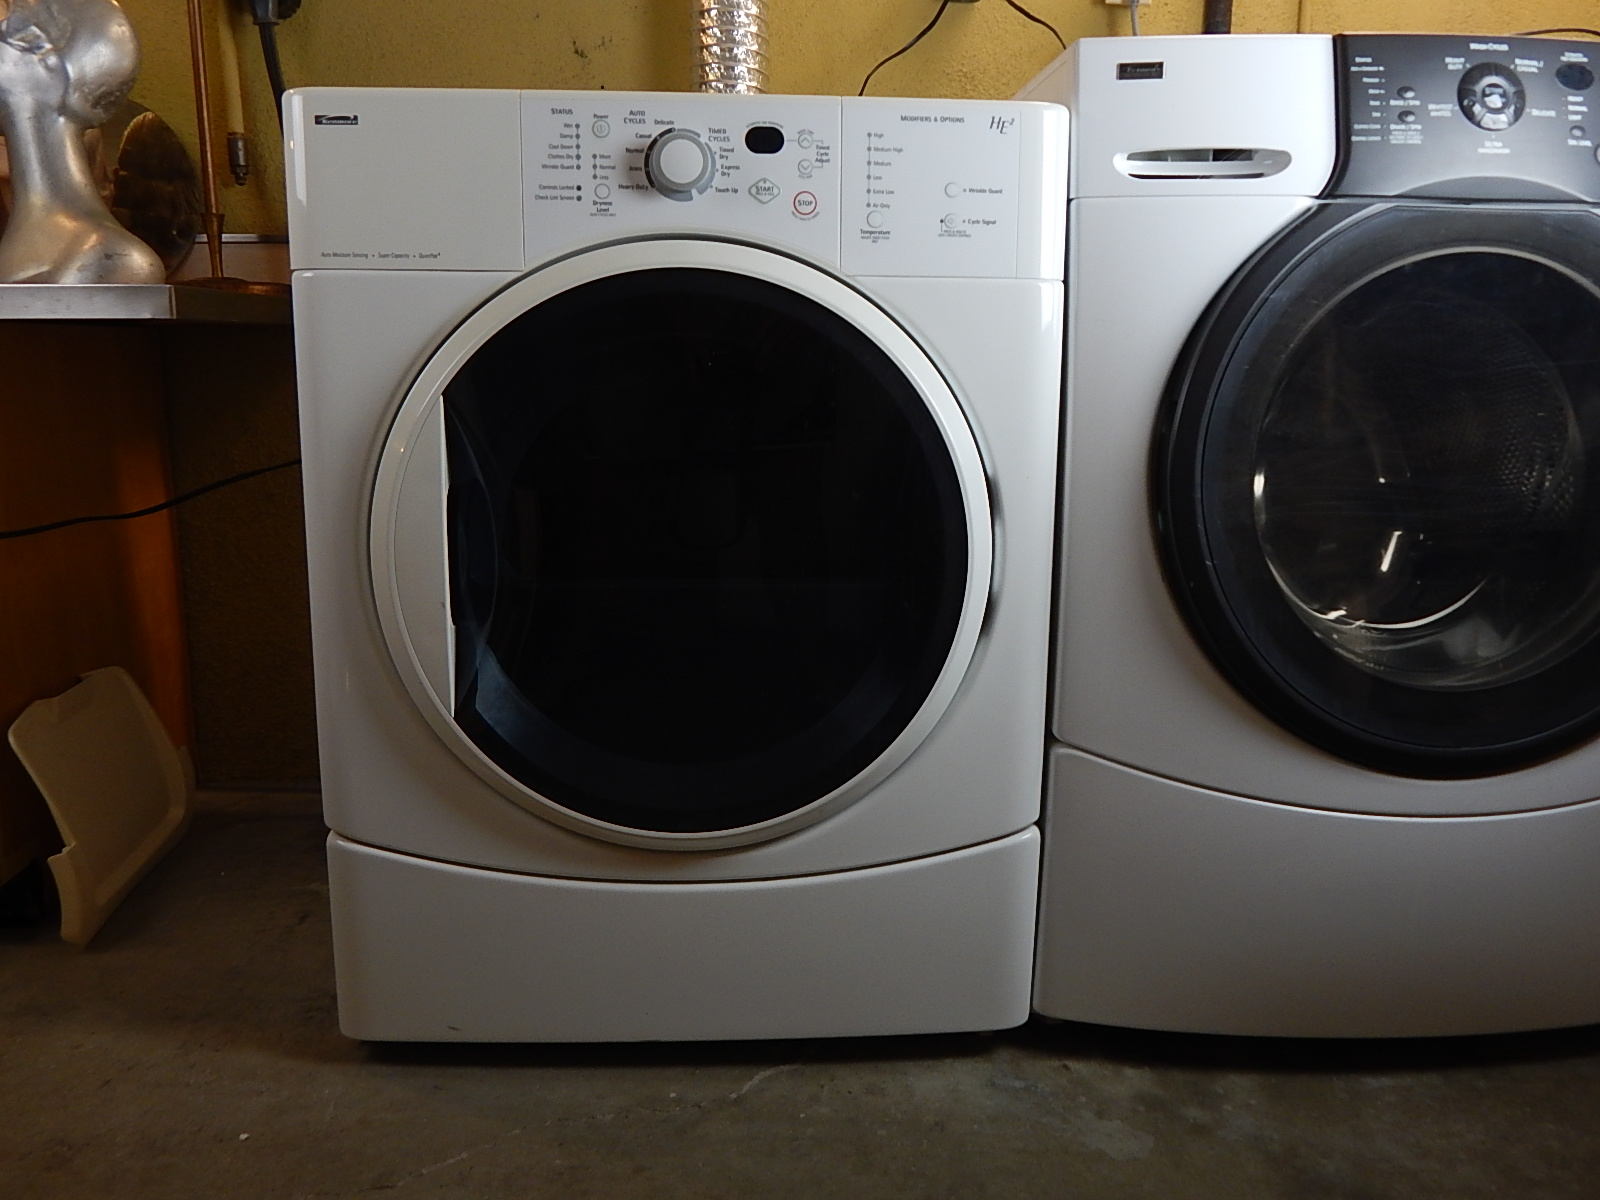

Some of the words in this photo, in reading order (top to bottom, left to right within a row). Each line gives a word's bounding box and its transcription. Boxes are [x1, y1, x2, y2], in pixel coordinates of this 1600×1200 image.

[755, 185, 774, 193] START
[797, 199, 813, 207] STOP
[860, 229, 891, 237] Temperature
